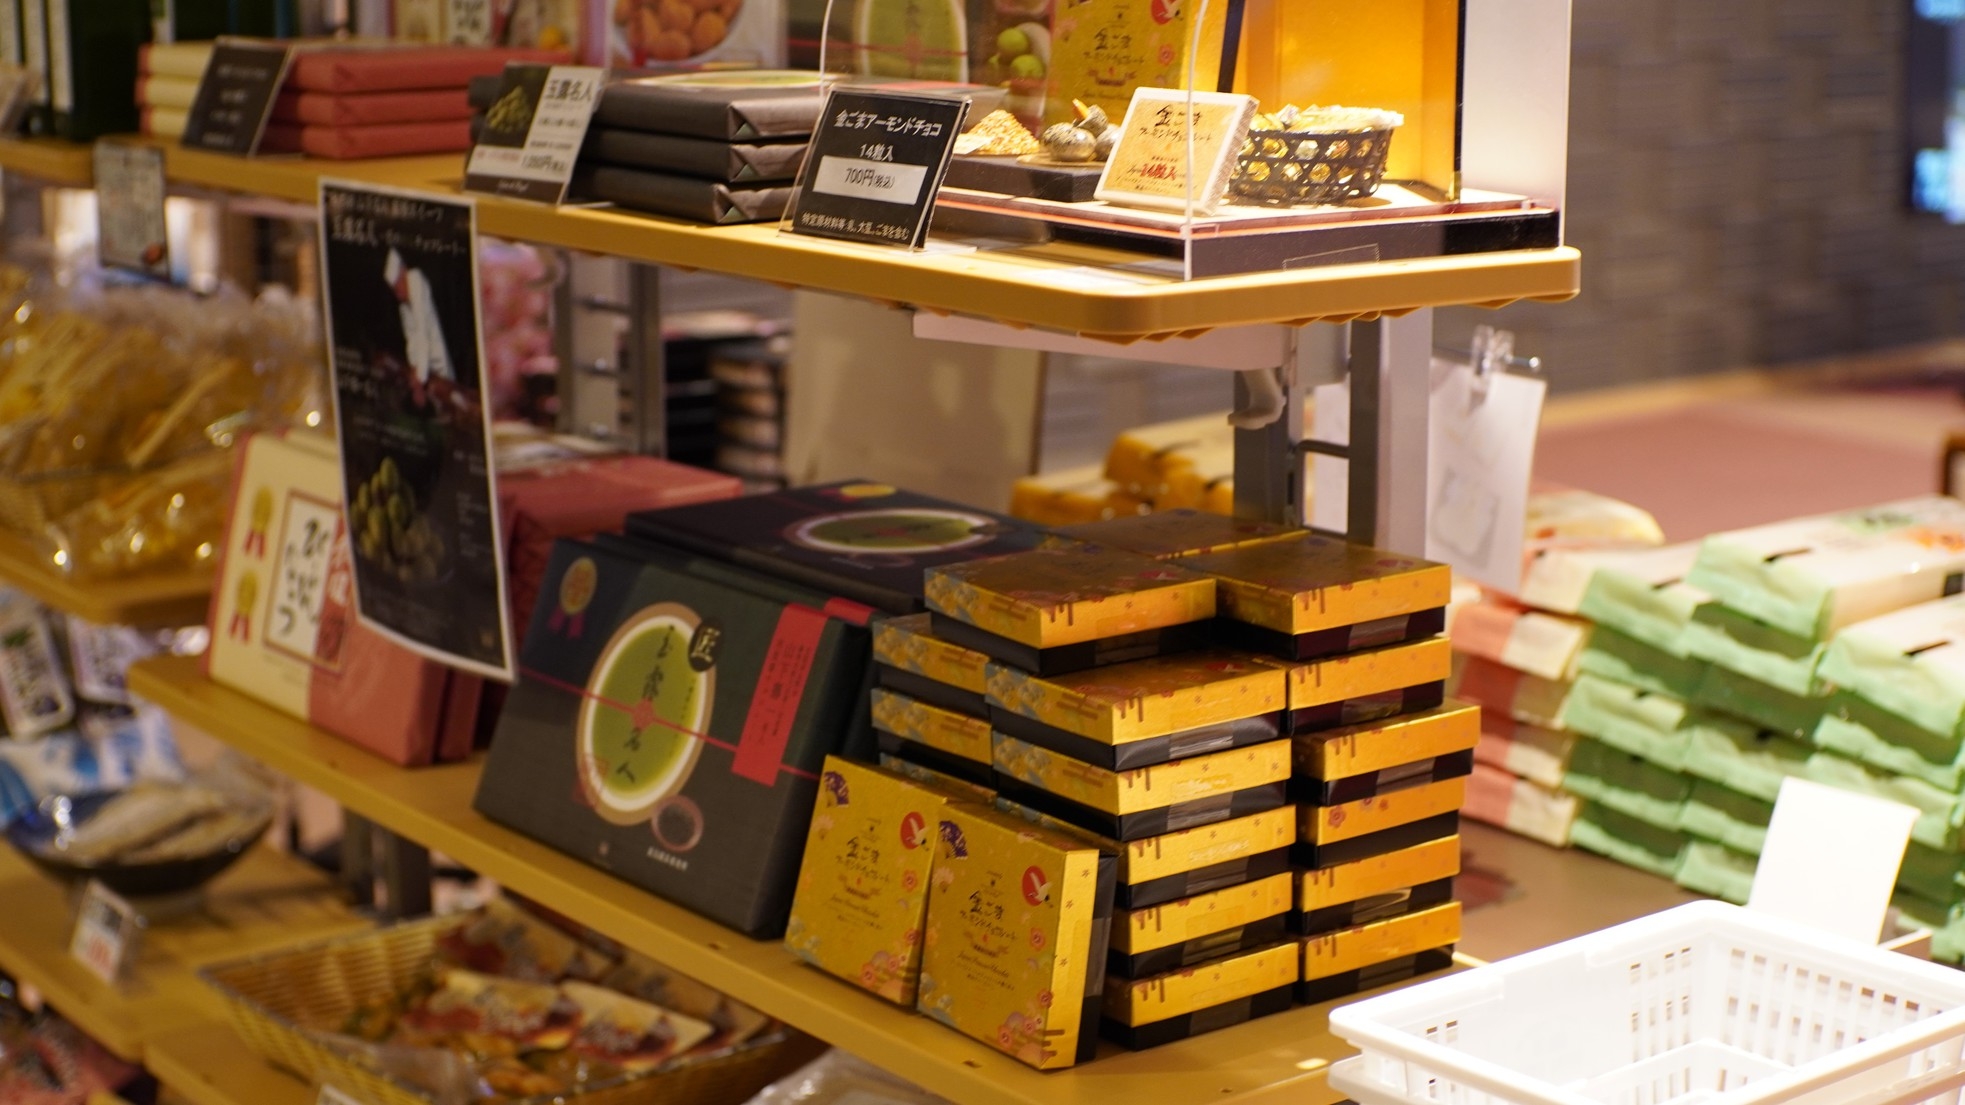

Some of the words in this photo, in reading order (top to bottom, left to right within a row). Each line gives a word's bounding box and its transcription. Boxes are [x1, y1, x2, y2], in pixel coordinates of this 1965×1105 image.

[544, 80, 593, 102] 玉露名人
[834, 109, 943, 137] 金ごまアーモンドチョコ
[859, 143, 894, 162] 14粒入
[691, 626, 721, 663] 匠
